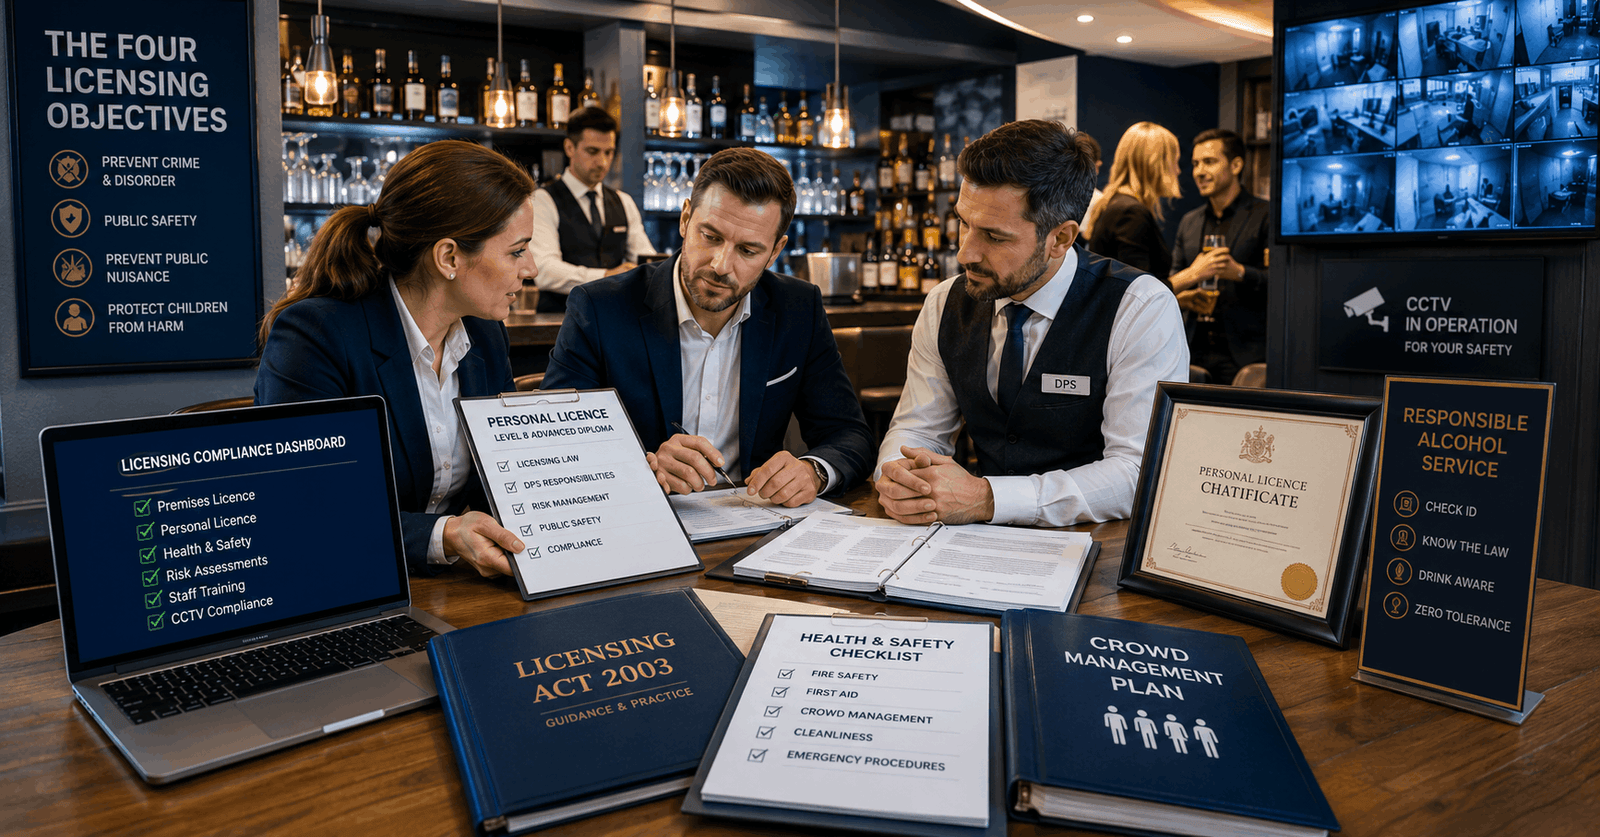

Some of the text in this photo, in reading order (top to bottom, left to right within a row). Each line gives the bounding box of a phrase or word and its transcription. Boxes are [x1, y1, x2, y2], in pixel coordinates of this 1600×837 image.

[45, 30, 197, 62] THE FOUR
[47, 67, 209, 98] LICENSING
[47, 102, 227, 132] OBJECTIVES
[102, 156, 200, 169] PREVENT CRIME
[102, 174, 176, 187] & DISORDER
[105, 215, 197, 227] PUBLIC SAFETY
[106, 252, 208, 265] PREVENT PUBLIC
[107, 271, 170, 283] NUISANCE
[108, 301, 228, 315] PROTECT CHILDREN
[1406, 296, 1451, 312] CCTV
[109, 320, 184, 334] FROM HARM
[1406, 317, 1517, 334] IN OPERATION
[1405, 341, 1512, 356] FOR YOUR SAFETY
[1055, 379, 1076, 389] DPS
[487, 408, 609, 427] PERSONAL LICENCE
[1403, 407, 1529, 431] RESPONSIBLE
[494, 424, 614, 442] LEVEL 8 ADVANCED DIPLOMA
[1417, 432, 1507, 454] ALCOHOL
[121, 435, 346, 473] LICENSING COMPLIANCE DASHBOARD
[516, 455, 579, 469] LICENSING LAW
[1422, 455, 1498, 478] SERVICE
[524, 471, 615, 489] DPS RESPONSIBILITIES
[1199, 466, 1307, 491] PERSONAL LICENCE
[157, 489, 255, 513] Premises Licence
[532, 493, 610, 510] RISK MANAGEMENT
[1201, 481, 1299, 509] CHATIFICATE
[1425, 501, 1477, 517] CHECK ID
[161, 512, 257, 536] Personal Licence
[539, 516, 601, 532] PUBLIC SAFETY
[163, 535, 252, 560] Health & Safety
[547, 538, 603, 554] COMPLIANCE
[1422, 535, 1509, 558] KNOW THE LAW
[166, 554, 268, 582] Risk Assessments
[1419, 570, 1495, 592] DRINK AWARE
[168, 580, 246, 604] Staff Training
[171, 594, 273, 625] CCTV Compliance
[1415, 604, 1511, 632] ZERO TOLERANCE
[800, 633, 954, 649] HEALTH & SAFETY
[1090, 636, 1189, 662] CROWD
[513, 632, 676, 678] LICENSING
[830, 648, 923, 662] CHECKLIST
[811, 670, 878, 681] FIRE SAFETY
[1065, 651, 1223, 685] MANAGEMENT
[533, 658, 673, 704] ACT 2003
[1111, 676, 1184, 700] PLAN
[806, 688, 858, 698] FIRST AID
[546, 687, 693, 728] GUIDANCE & PRACTICE
[800, 707, 933, 724] CROWD MANAGEMENT
[794, 728, 873, 742] CLEANLINESS
[787, 750, 945, 771] EMERGENCY PROCEDURES
